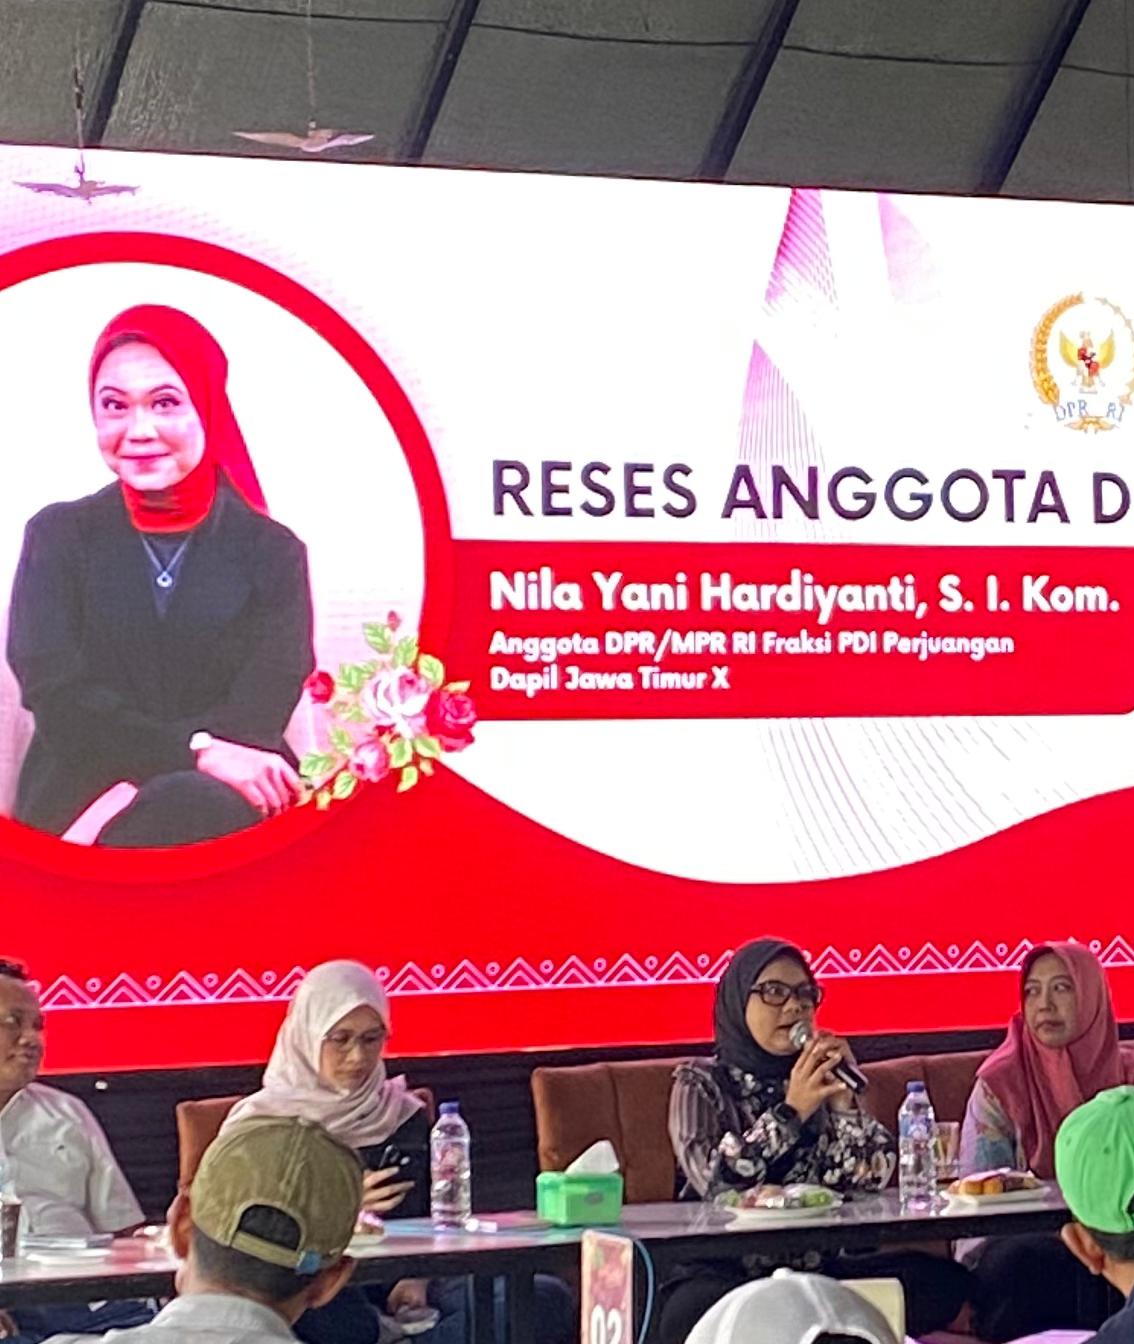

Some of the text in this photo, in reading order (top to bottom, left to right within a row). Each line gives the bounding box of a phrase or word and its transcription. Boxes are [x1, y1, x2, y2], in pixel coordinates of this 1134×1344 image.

[492, 459, 698, 519] RESES
[721, 463, 1071, 525] ANGGOTA
[489, 566, 1120, 626] Nila Yani Hardiyanti, S. I. Kom.
[488, 628, 1015, 663] Anggota DPR/MPR RI Fraksi PDI Perjuangan
[489, 665, 731, 698] Dapil Jawa Timur X
